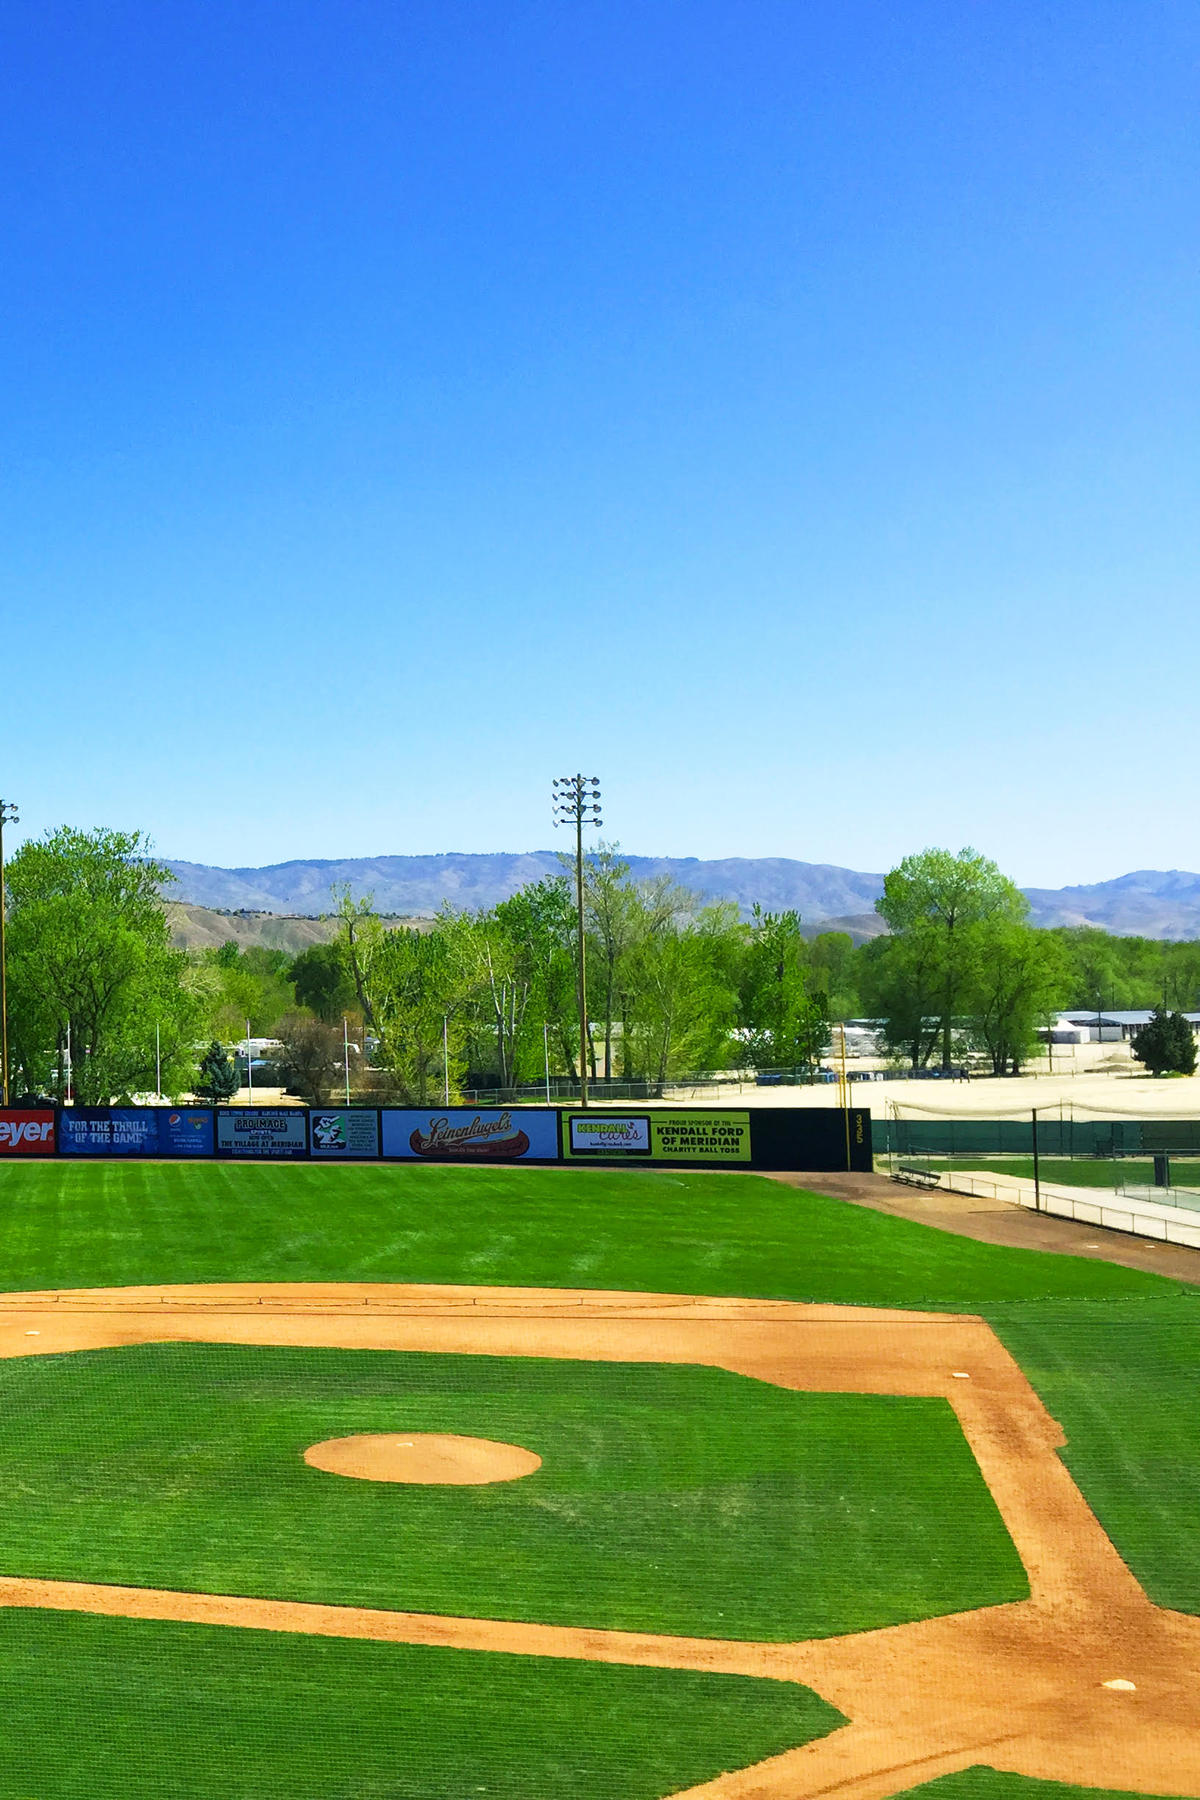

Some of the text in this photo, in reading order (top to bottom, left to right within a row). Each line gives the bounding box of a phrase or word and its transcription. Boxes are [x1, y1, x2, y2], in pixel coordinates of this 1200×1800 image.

[68, 1120, 148, 1132] FOR THE THRILL
[577, 1124, 628, 1133] KENDALL
[657, 1127, 744, 1136] KENDALL FORD
[75, 1132, 143, 1144] OF THE GAME
[662, 1136, 740, 1146] OF MERIDIAN
